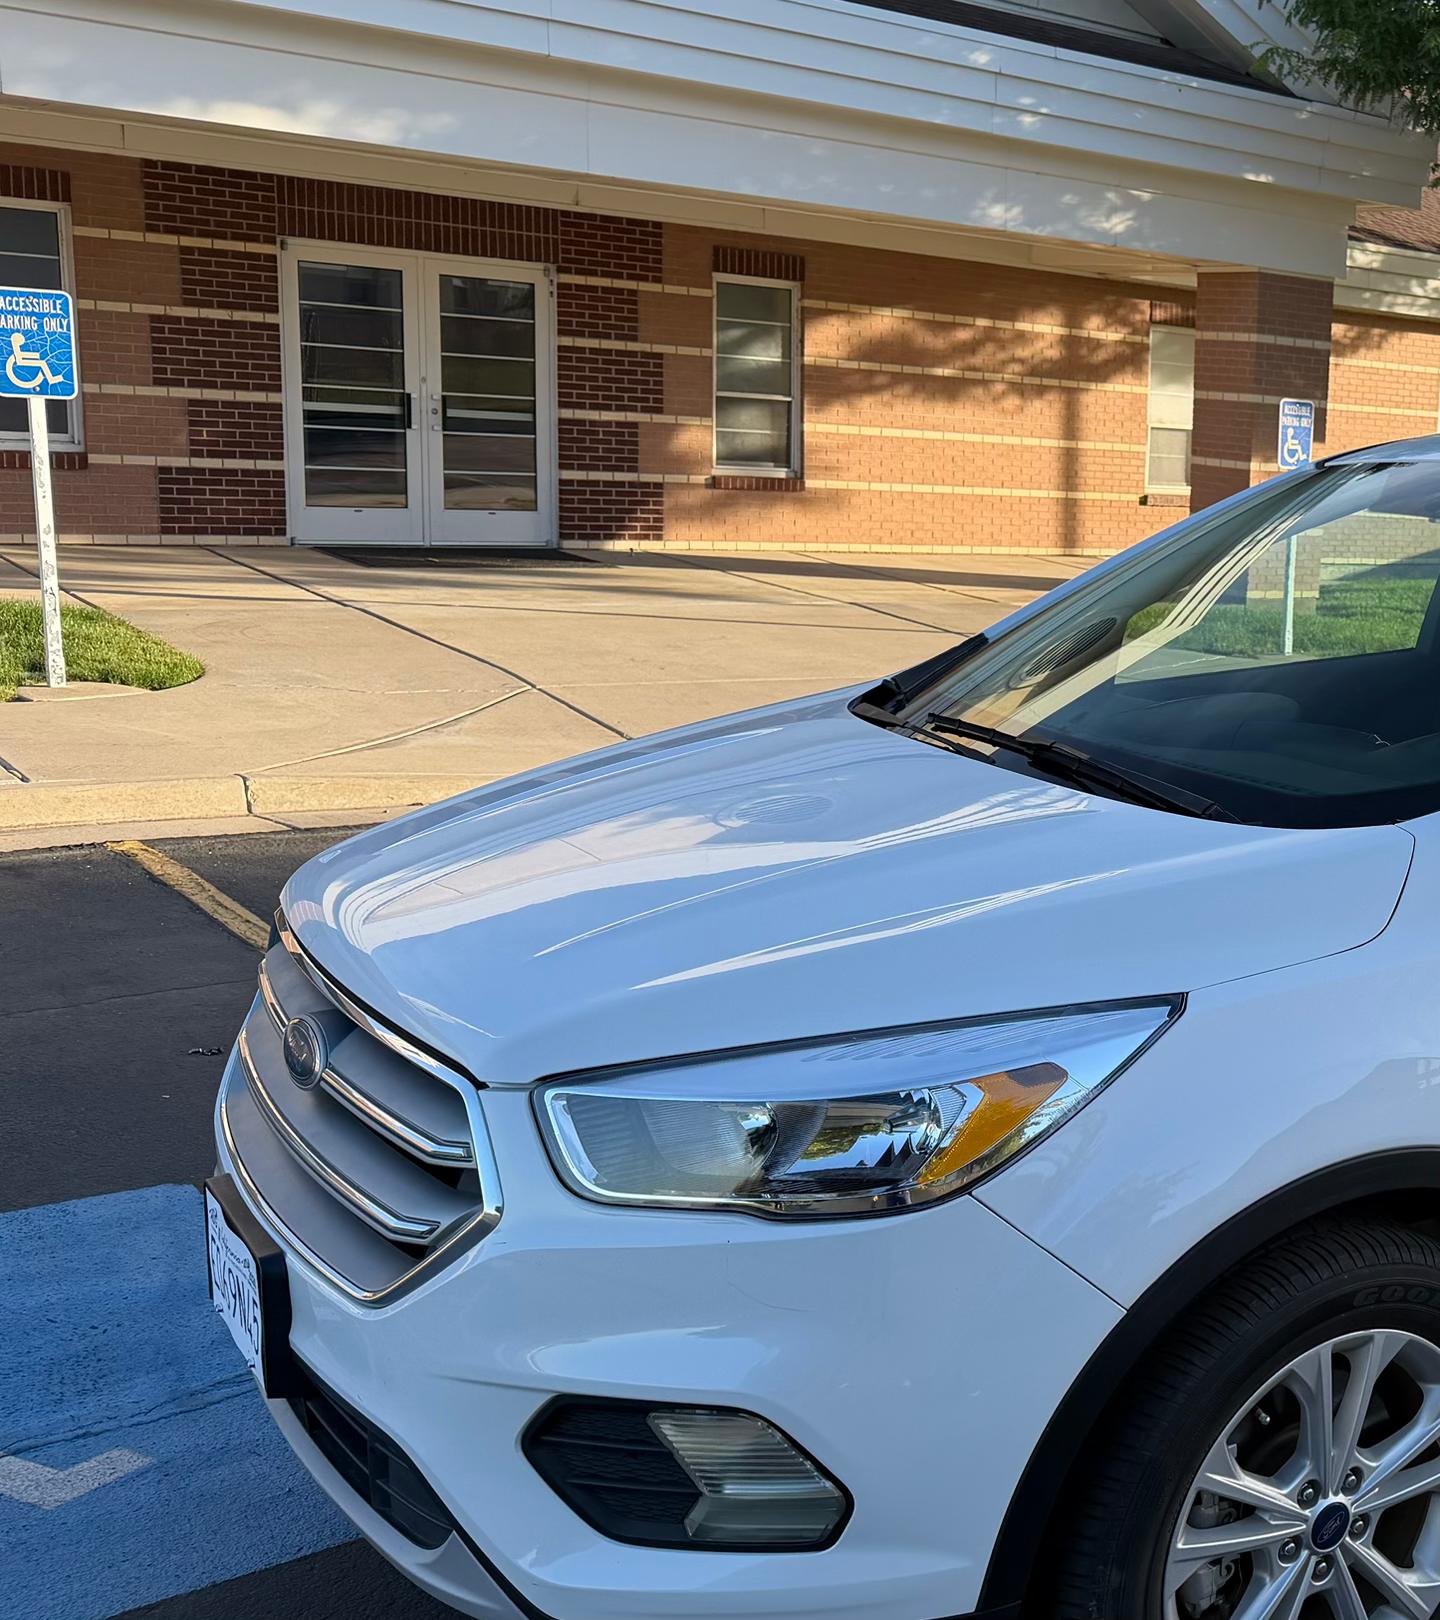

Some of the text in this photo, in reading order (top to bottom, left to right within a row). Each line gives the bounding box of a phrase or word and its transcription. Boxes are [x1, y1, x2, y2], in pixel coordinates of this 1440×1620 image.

[0, 296, 62, 313] ACCESSIBLE
[0, 314, 68, 332] ARKING ONLY
